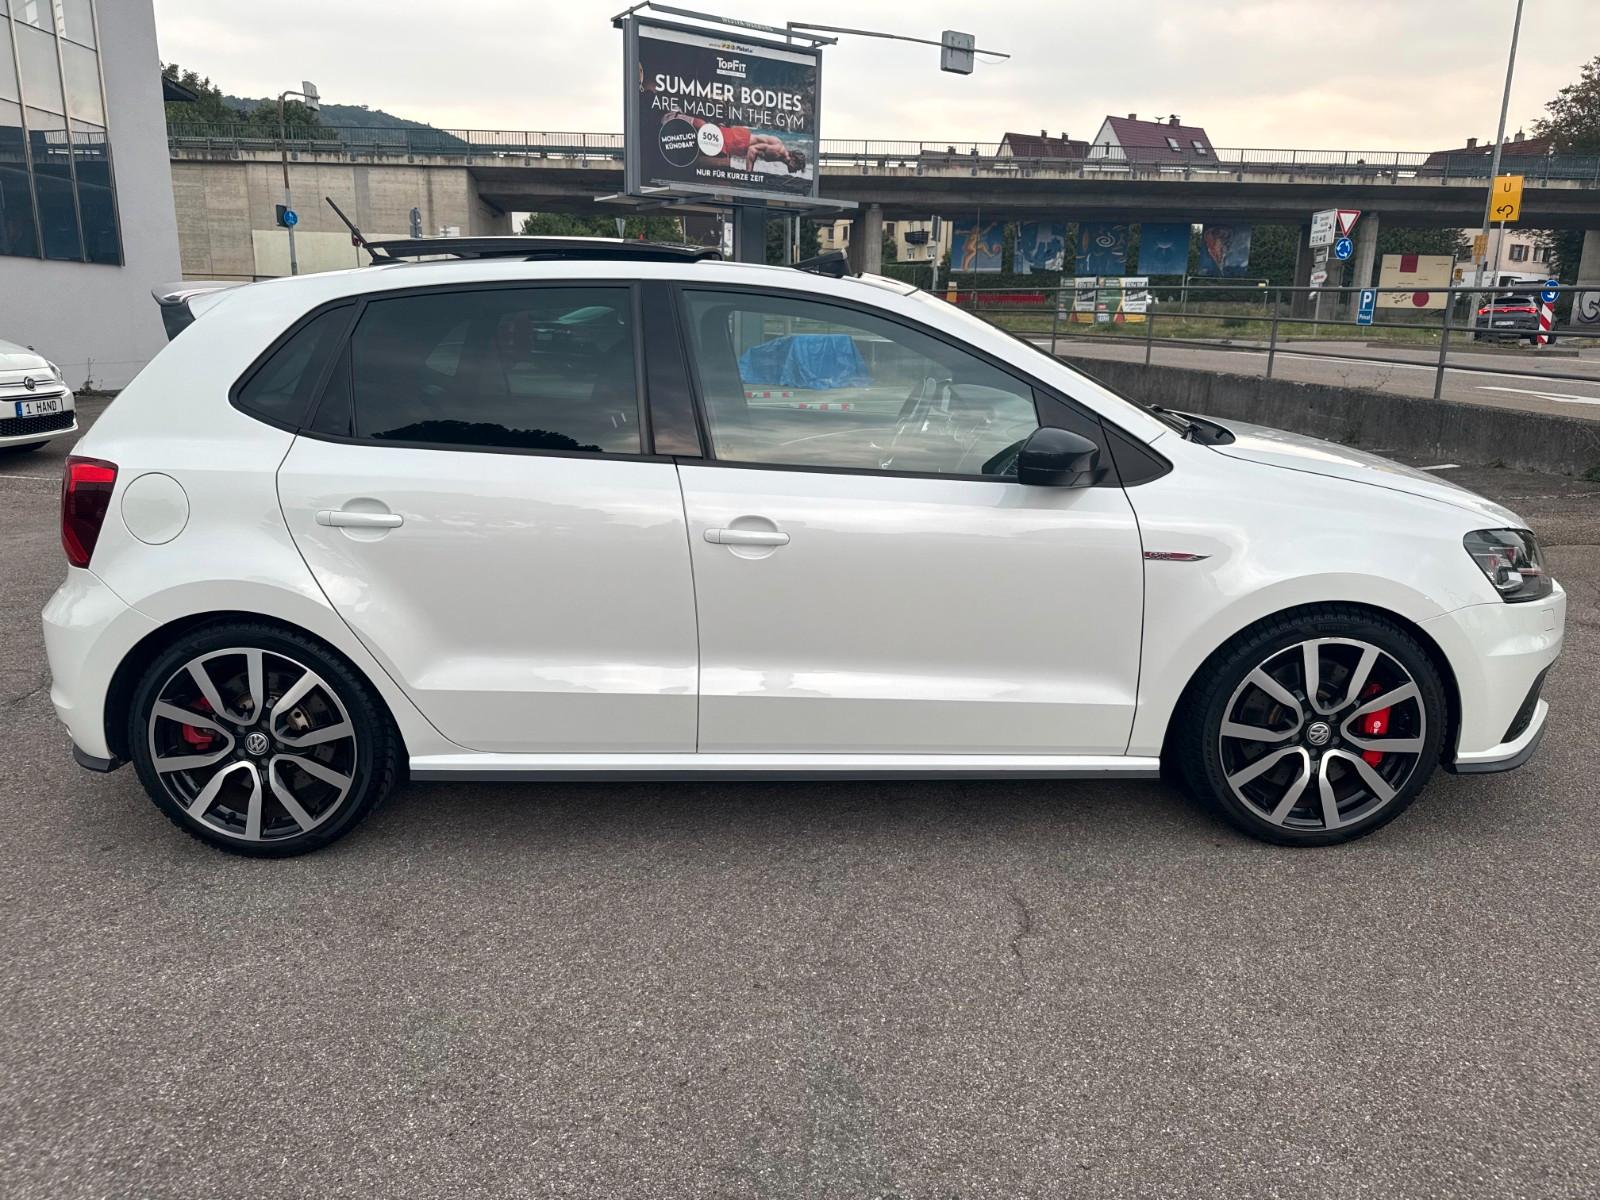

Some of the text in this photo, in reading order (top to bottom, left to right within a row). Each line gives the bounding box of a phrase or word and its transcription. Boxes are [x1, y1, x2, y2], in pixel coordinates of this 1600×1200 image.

[655, 74, 802, 112] SUMMER BODIES
[651, 95, 804, 129] ARE MADE IN THE GYM
[661, 132, 696, 143] MONATLICH
[702, 131, 719, 142] 50%
[696, 168, 764, 183] NUR FÜR KURZE ZEIT
[1503, 182, 1512, 193] U
[1362, 291, 1372, 309] P
[25, 400, 57, 414] 1 HAND
